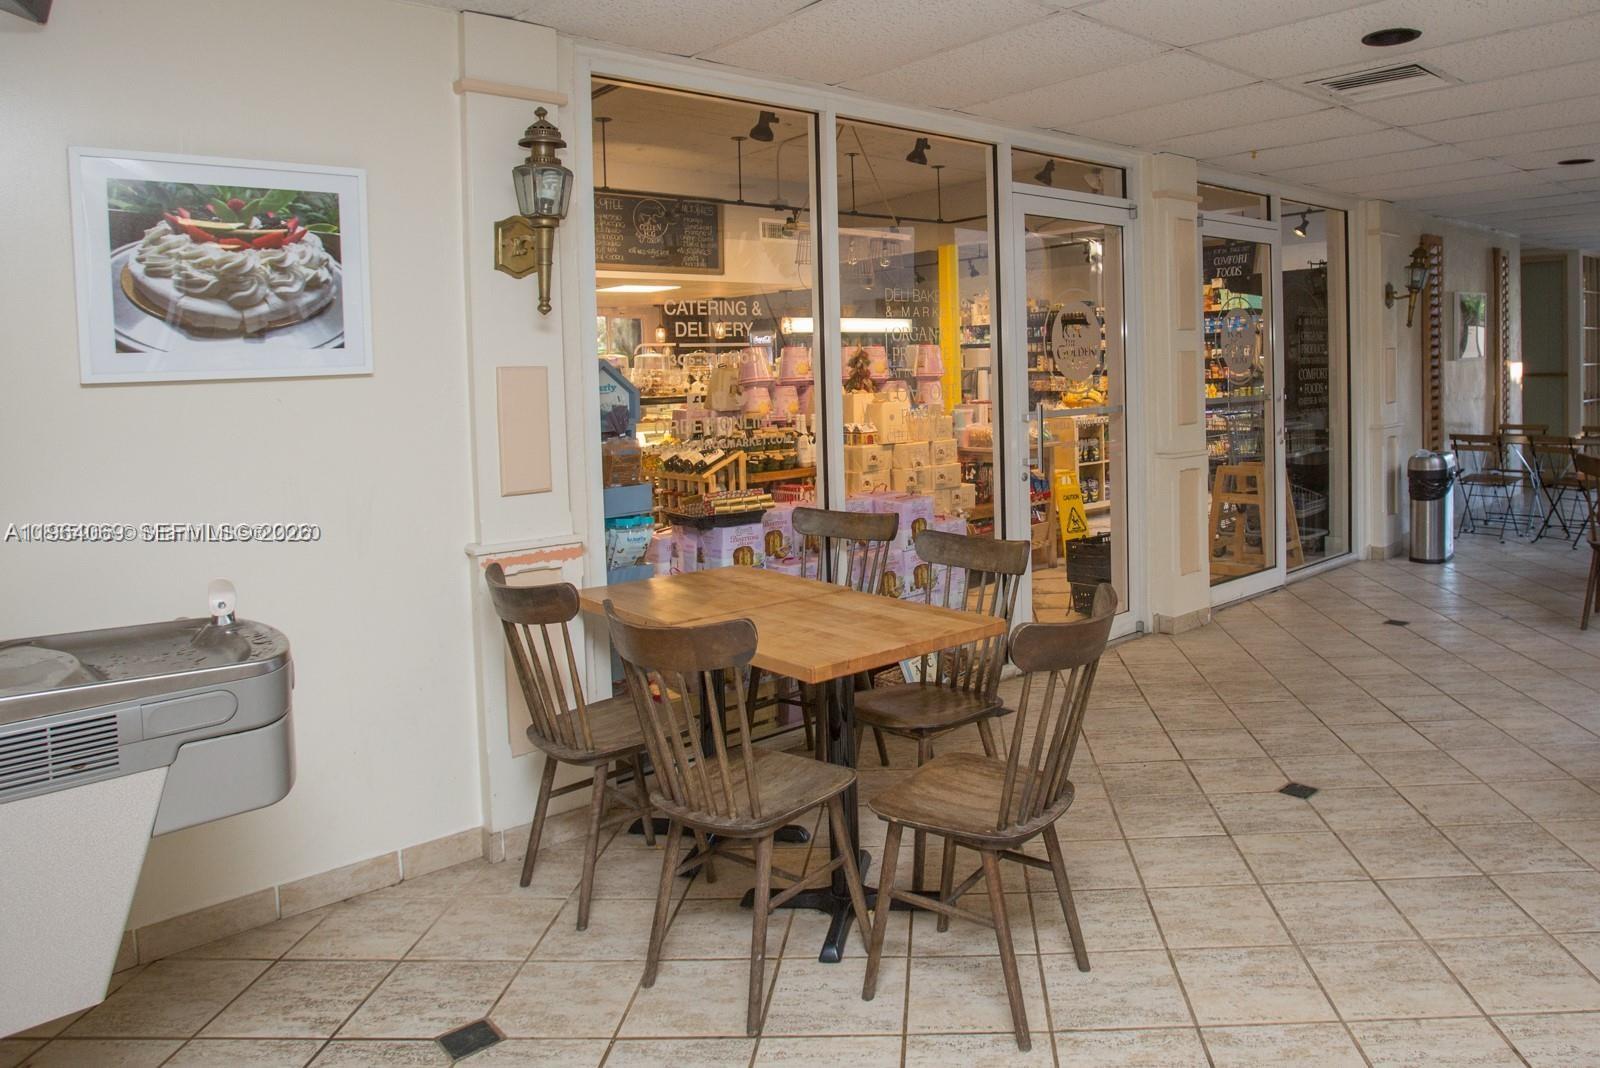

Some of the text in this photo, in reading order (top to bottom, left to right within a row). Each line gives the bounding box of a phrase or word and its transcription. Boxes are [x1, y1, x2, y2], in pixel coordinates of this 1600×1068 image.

[1216, 265, 1242, 277] FOODS
[884, 287, 909, 302] DELI
[664, 300, 762, 316] CATERING &
[675, 322, 753, 338] DELIVERY
